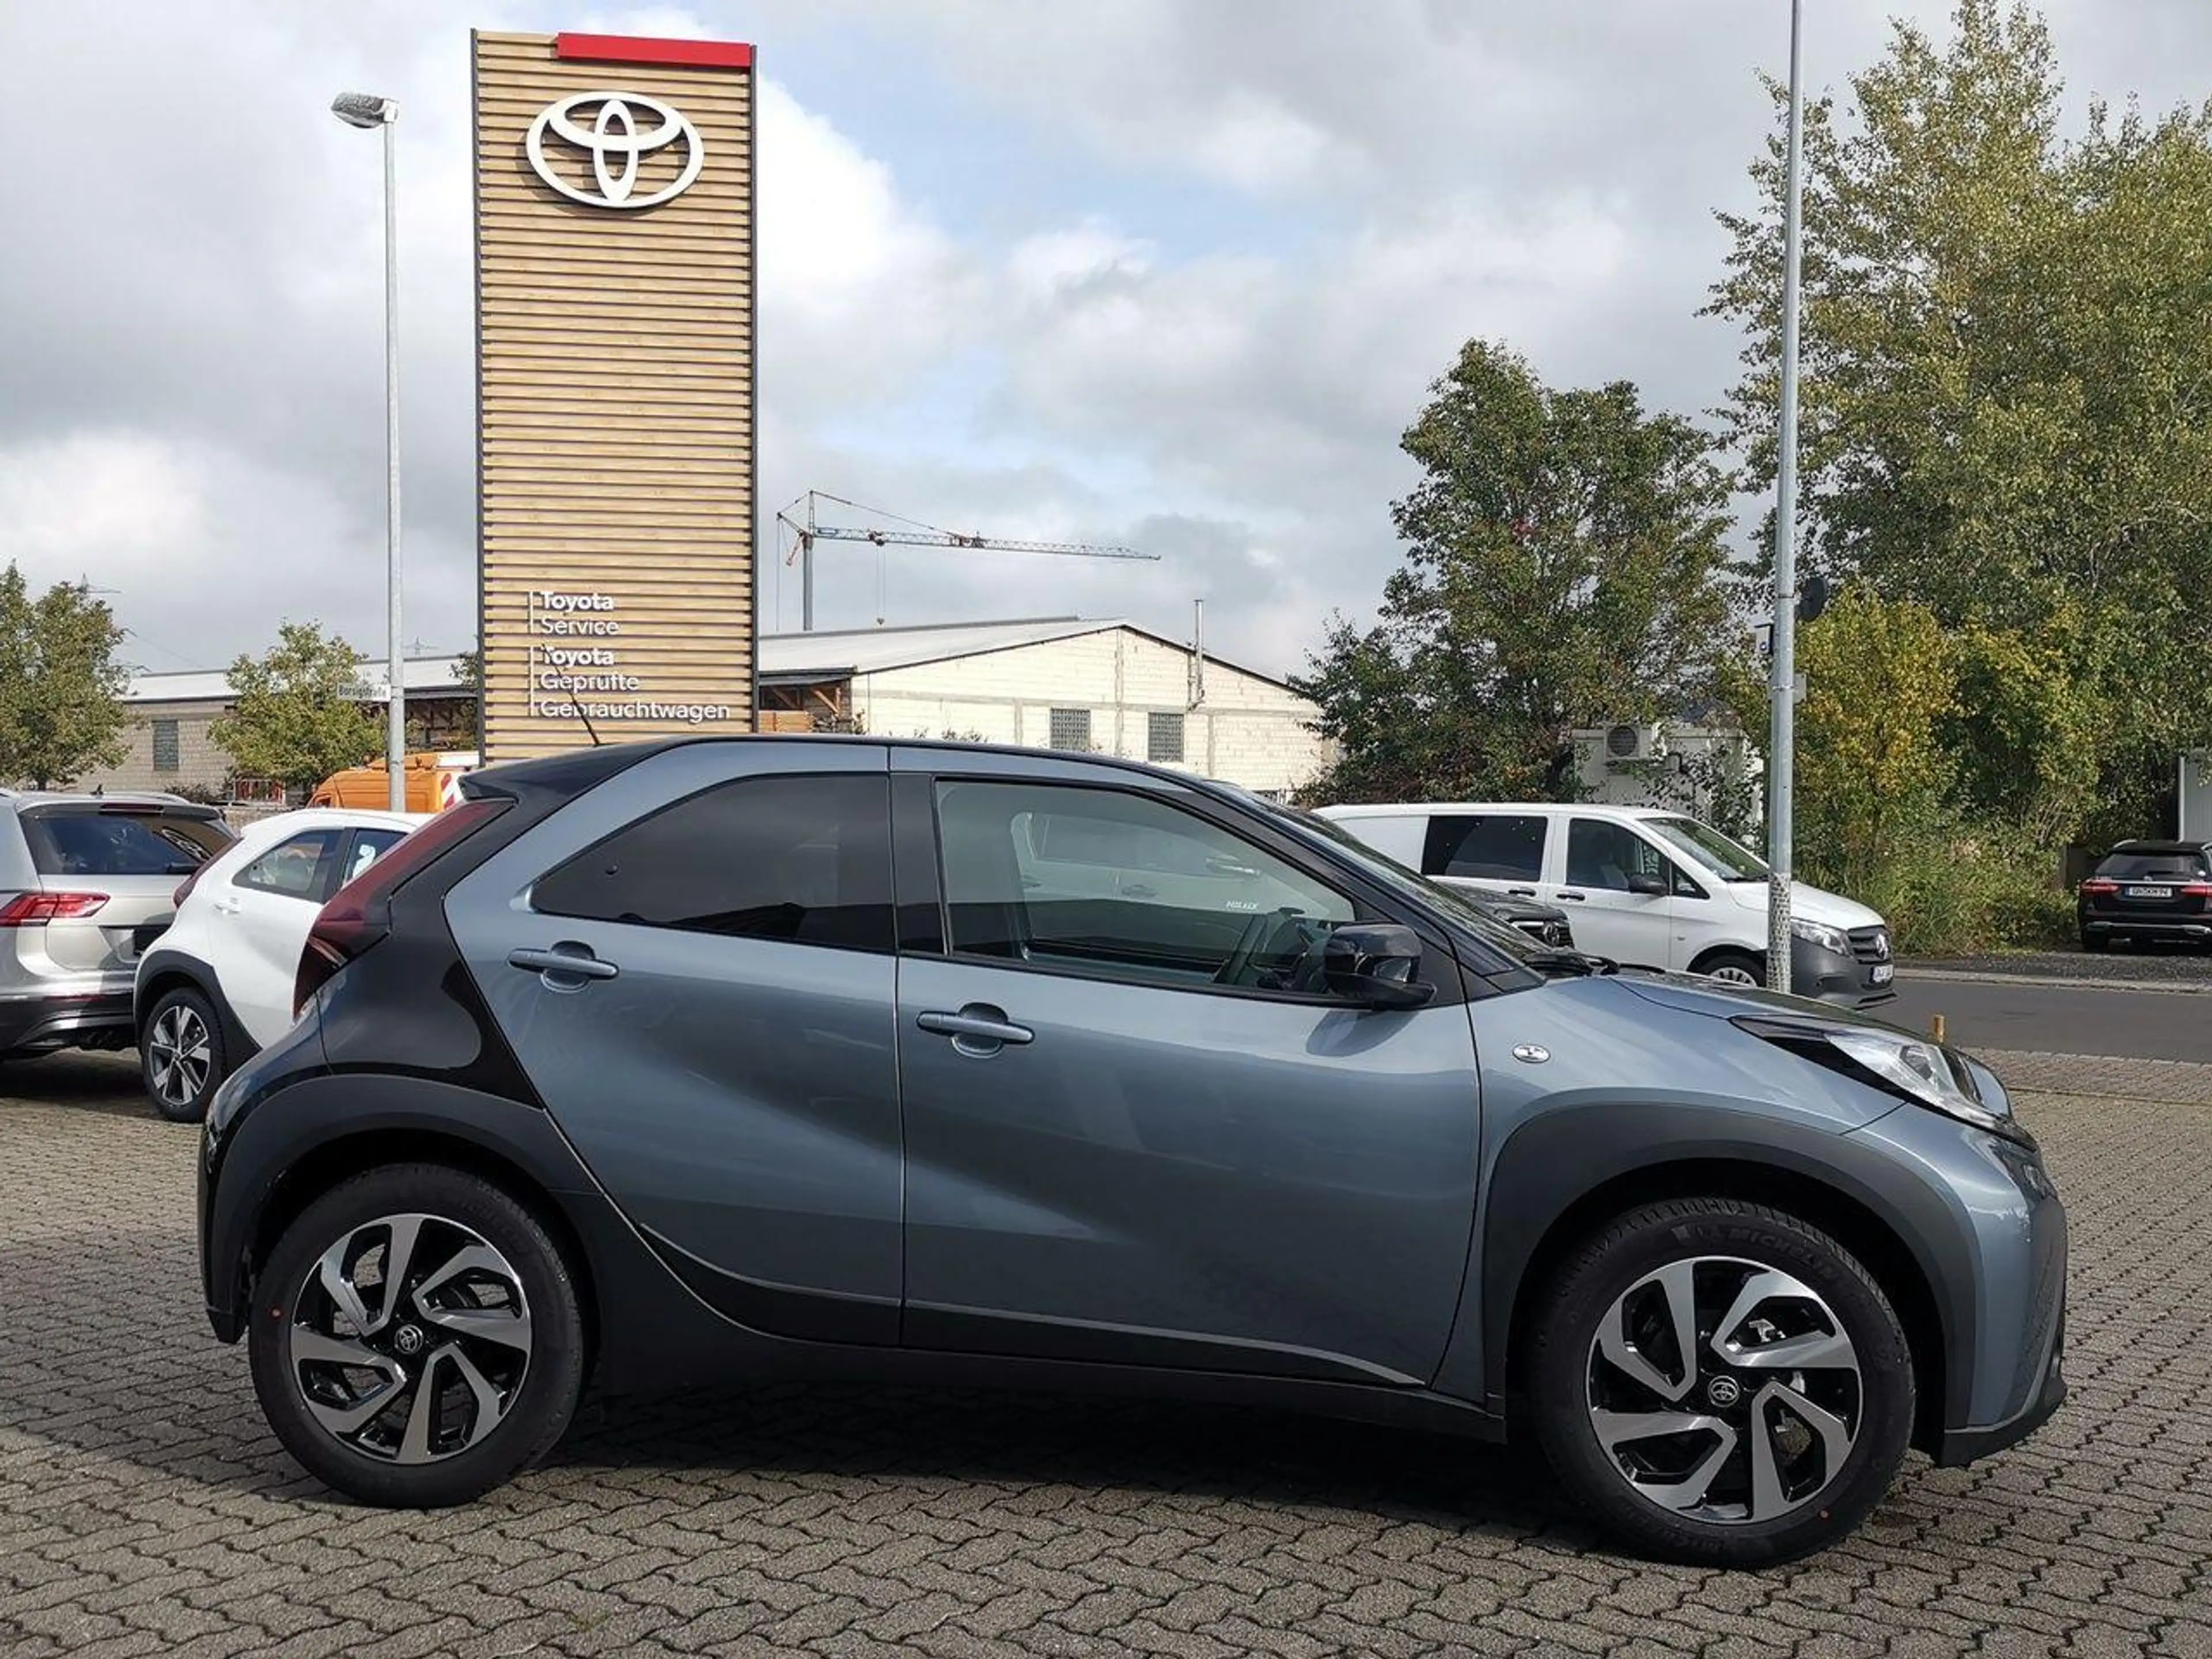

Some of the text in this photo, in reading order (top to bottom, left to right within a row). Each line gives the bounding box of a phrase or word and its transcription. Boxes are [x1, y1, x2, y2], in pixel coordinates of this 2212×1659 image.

[540, 591, 615, 612] Toyota
[540, 616, 621, 635] Service
[540, 646, 615, 667] Toyota
[540, 671, 640, 694] Geprüfte
[540, 699, 731, 724] Gebrauchtwagen
